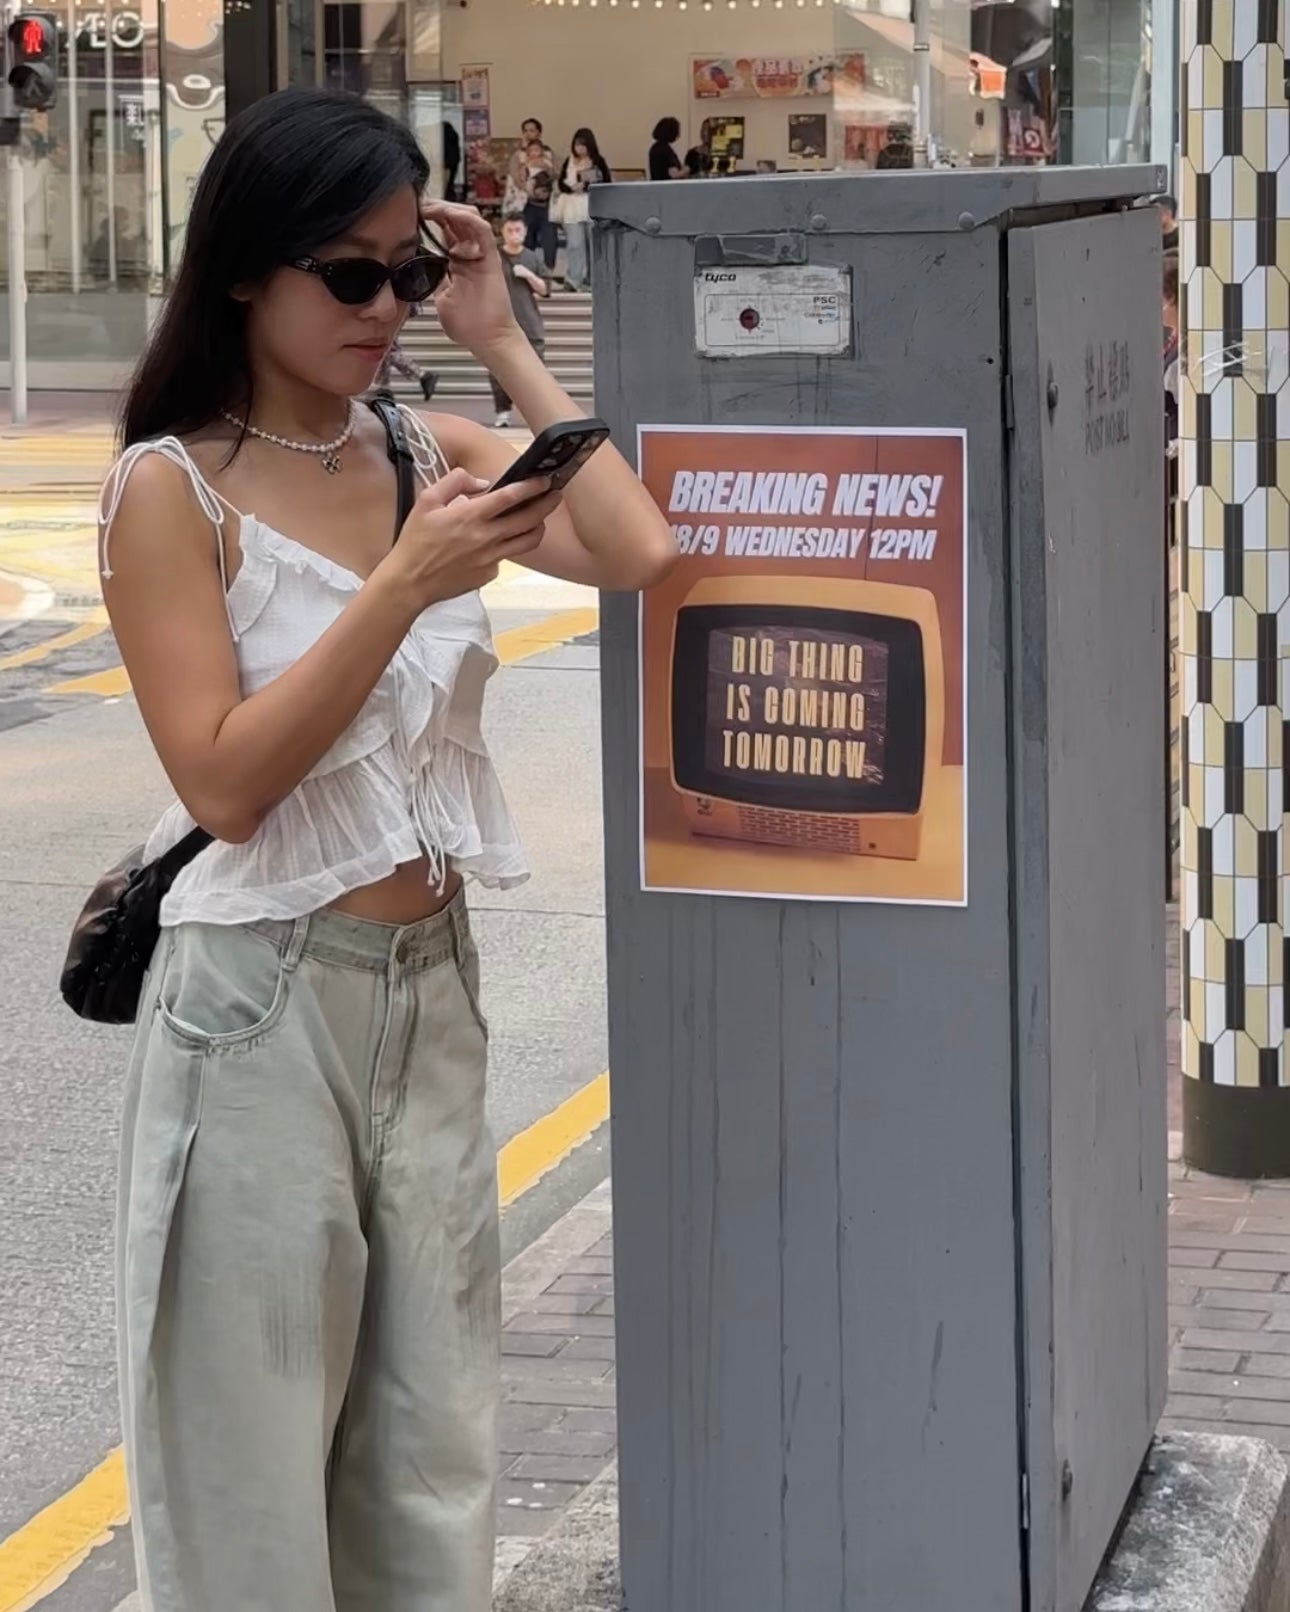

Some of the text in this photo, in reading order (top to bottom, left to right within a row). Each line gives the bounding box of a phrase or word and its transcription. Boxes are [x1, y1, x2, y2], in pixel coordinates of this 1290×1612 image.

[705, 272, 737, 283] tyco
[813, 296, 836, 304] PSC
[668, 470, 944, 518] BREAKING NEWS!
[724, 525, 866, 559] WEDNESDAY
[868, 529, 938, 560] 12PM
[731, 636, 864, 683] BIG THING
[726, 683, 865, 731] IS COMING
[722, 730, 866, 779] TOMORROW
